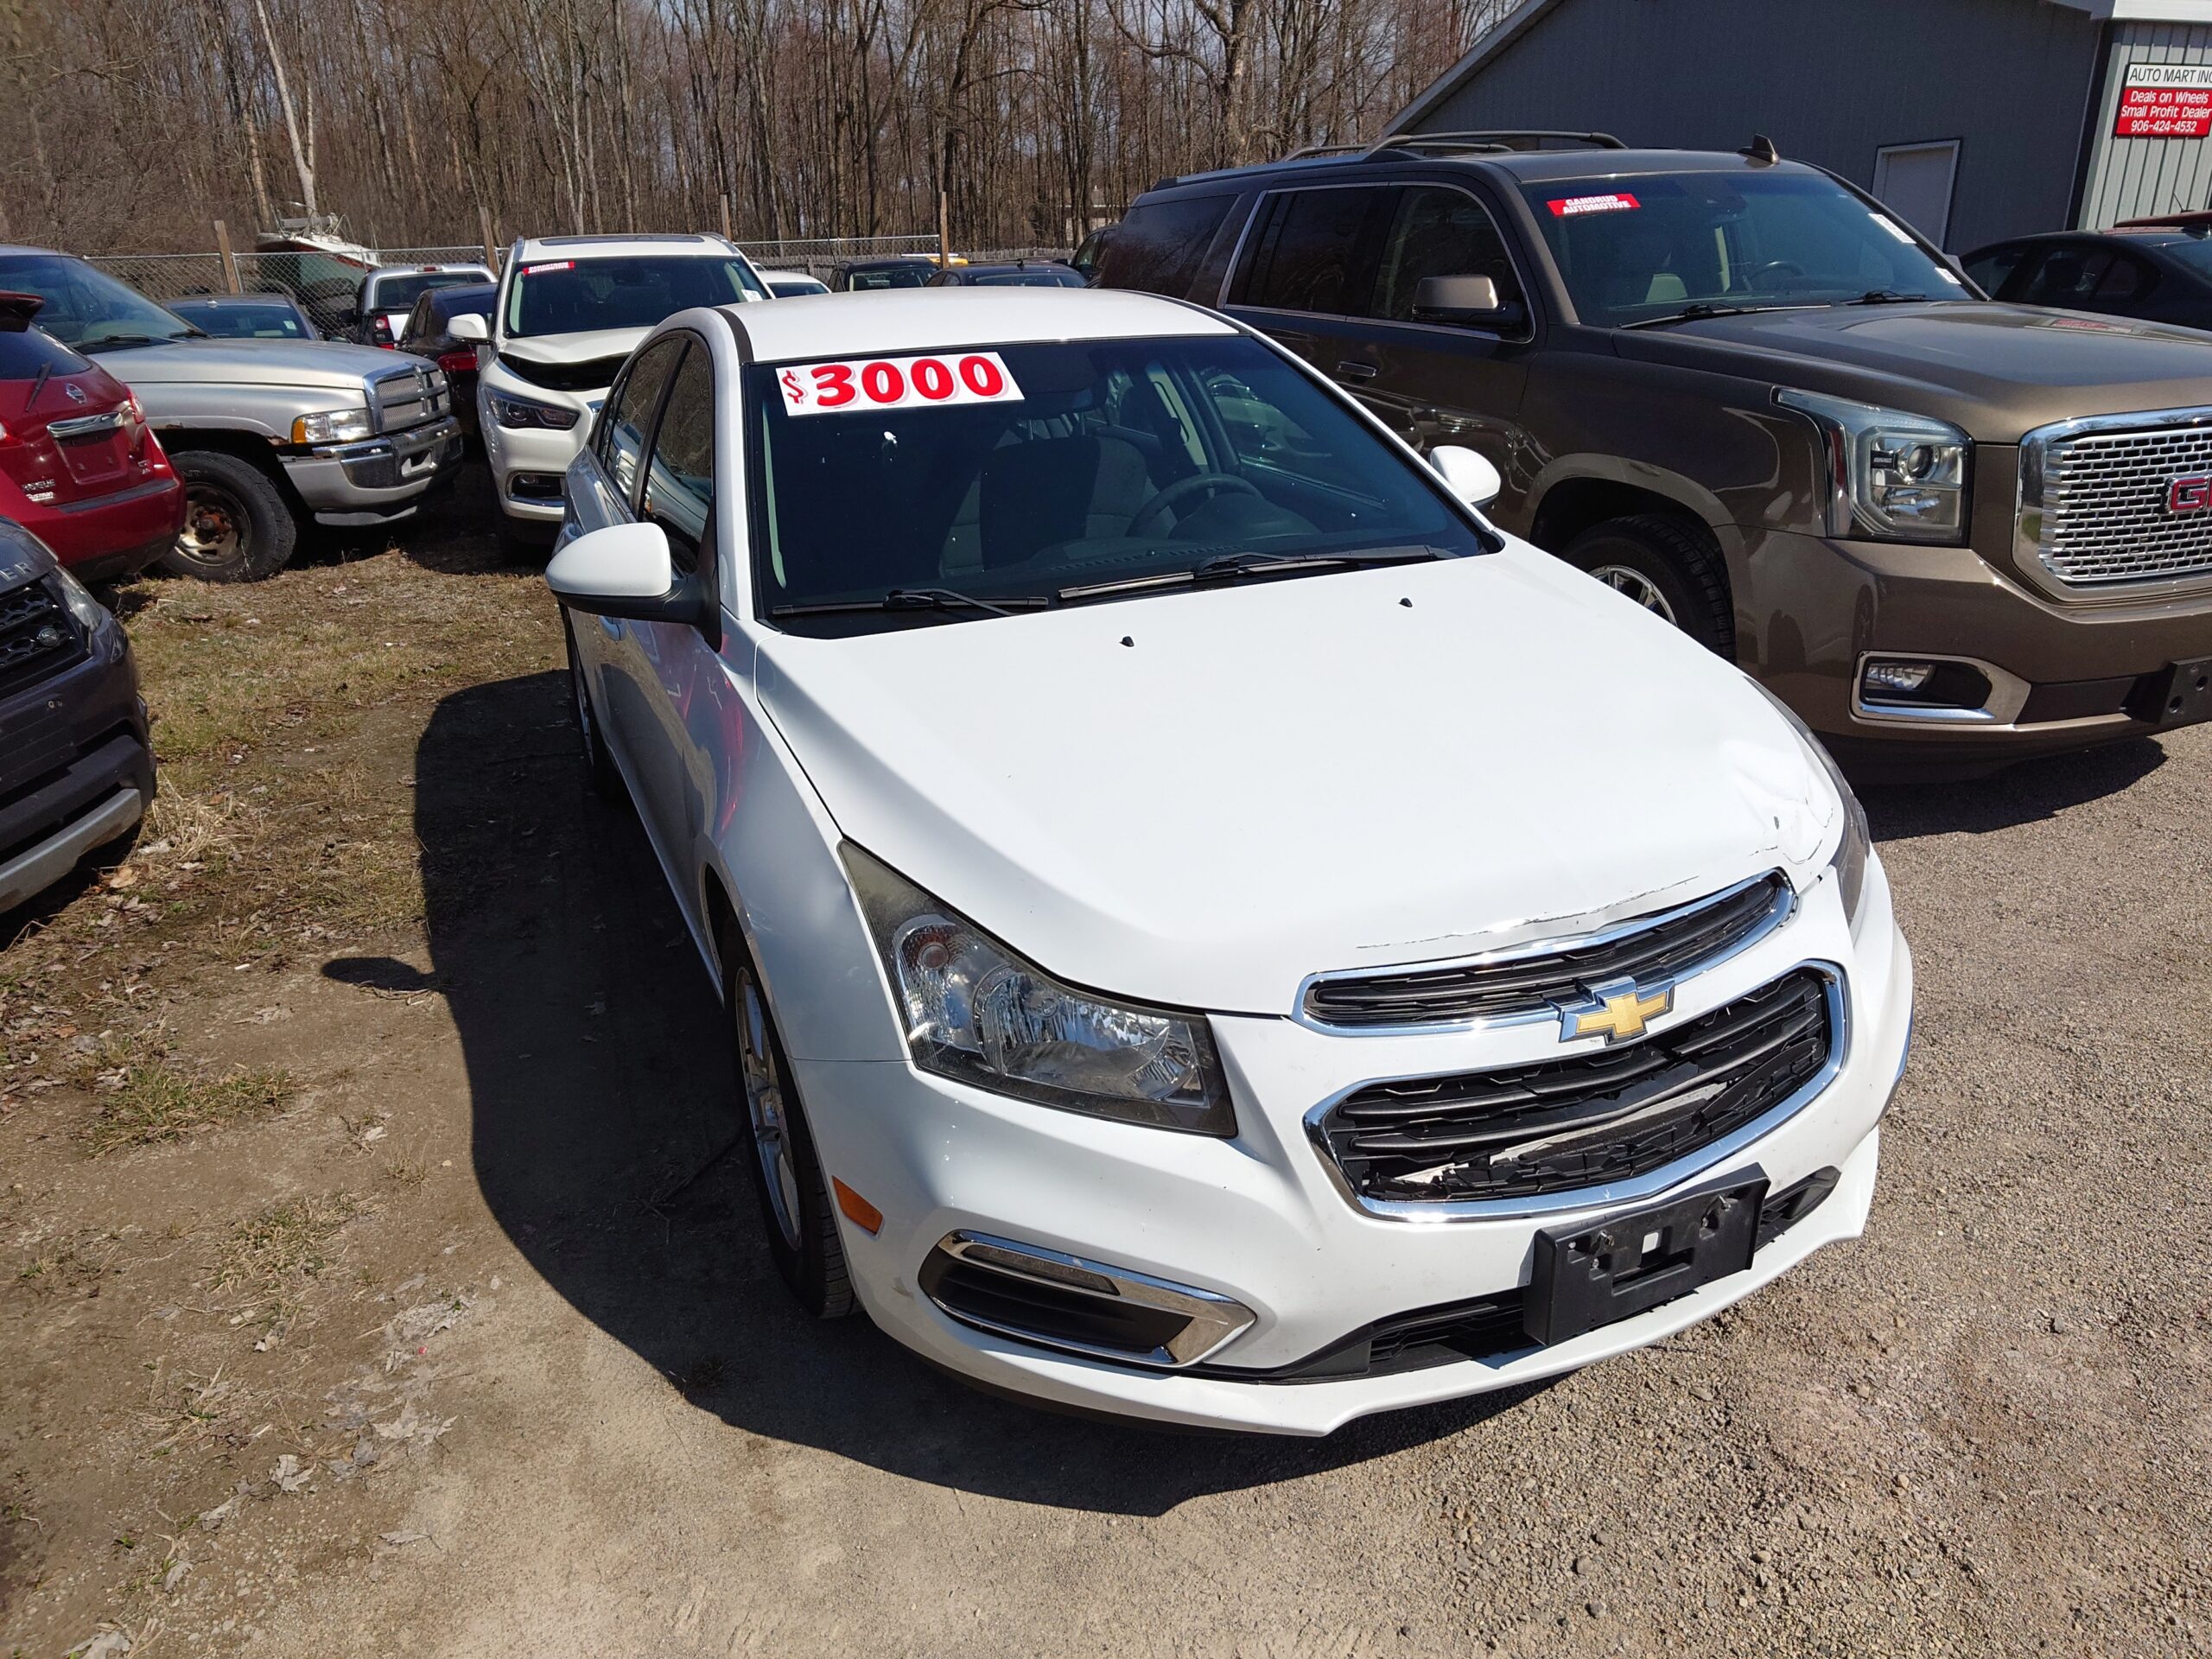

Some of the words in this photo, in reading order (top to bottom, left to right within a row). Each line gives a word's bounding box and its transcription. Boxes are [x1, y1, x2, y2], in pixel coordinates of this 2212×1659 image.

[2129, 68, 2161, 82] AUTO
[2164, 69, 2196, 83] MART
[2130, 90, 2157, 103] Deals
[2159, 92, 2172, 103] on
[2175, 92, 2209, 104] Wheels
[2120, 105, 2148, 118] Small
[2150, 105, 2180, 118] Profit
[2182, 106, 2212, 118] Dealer
[2131, 119, 2197, 132] 906-424-4532
[1562, 200, 1632, 214] AUTOMOTIVE
[1565, 194, 1618, 206] GANDRUD
[782, 355, 1006, 407] $3000
